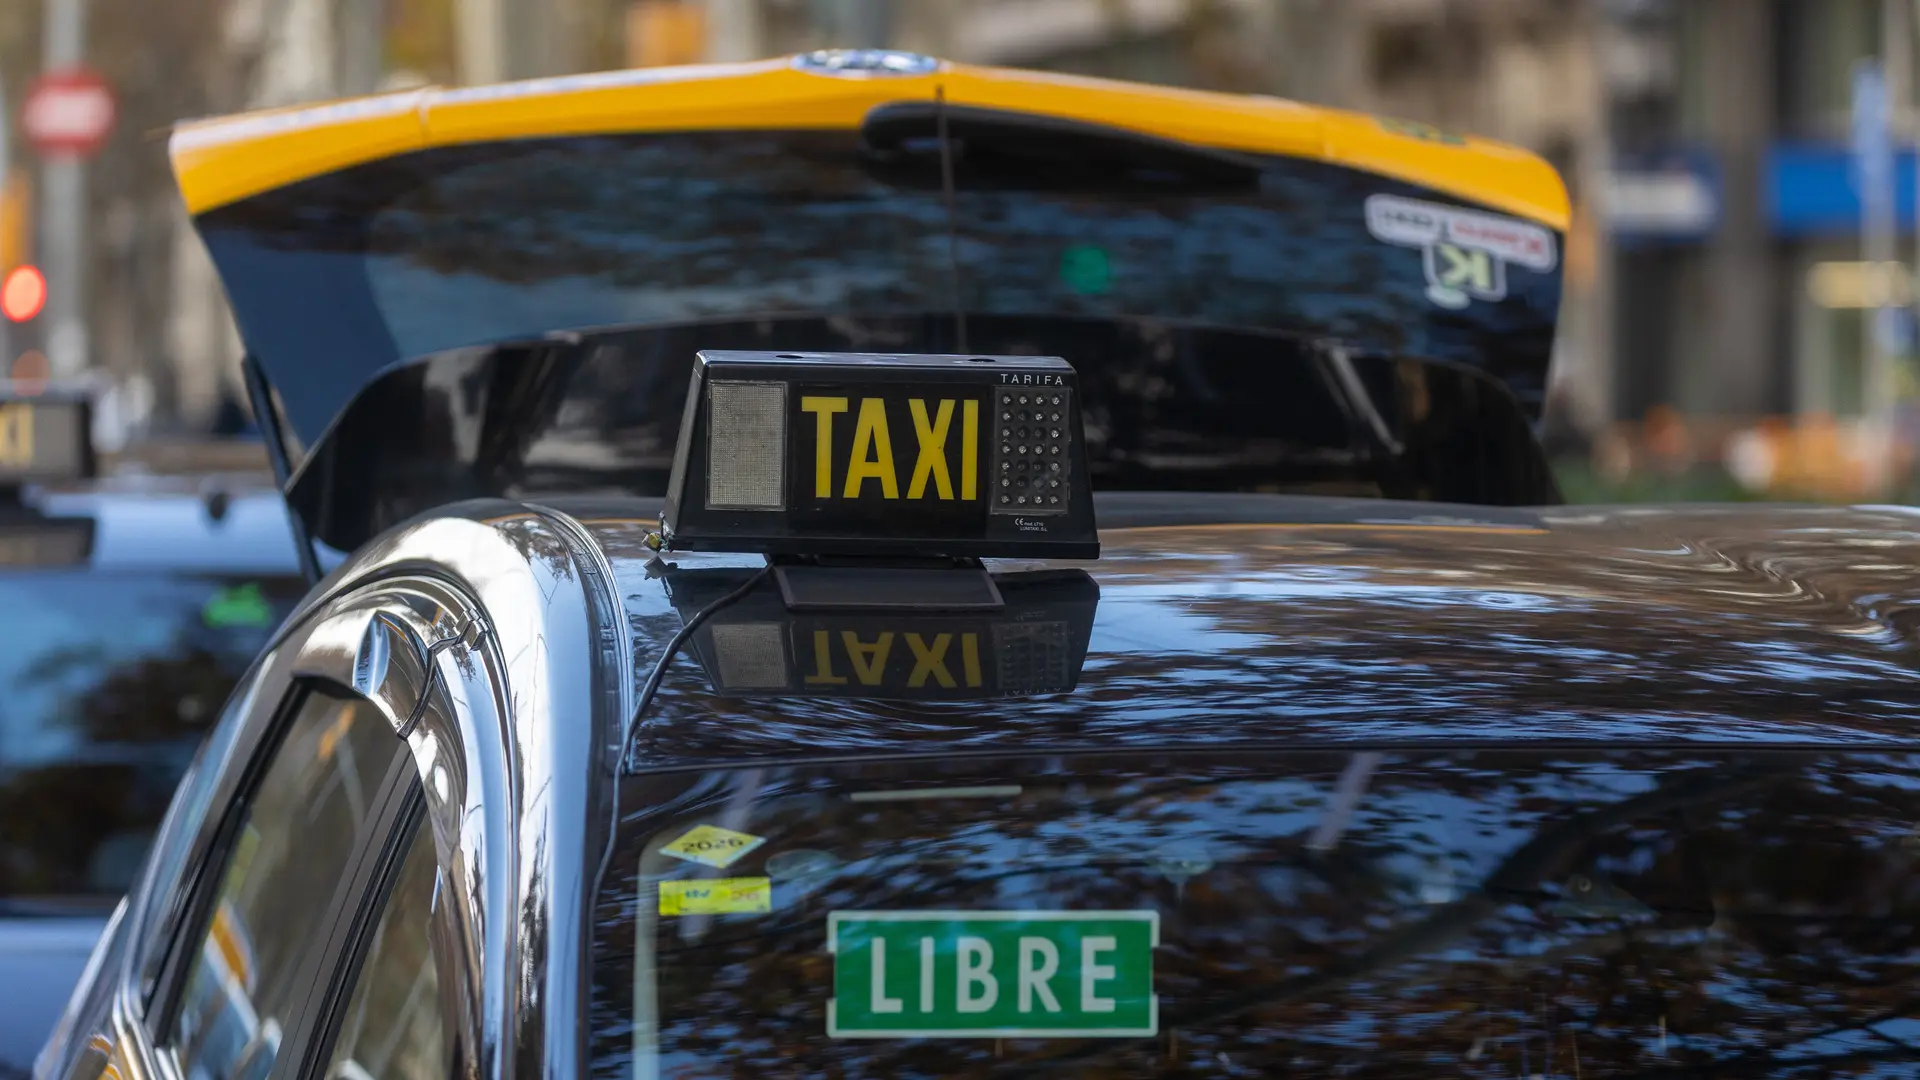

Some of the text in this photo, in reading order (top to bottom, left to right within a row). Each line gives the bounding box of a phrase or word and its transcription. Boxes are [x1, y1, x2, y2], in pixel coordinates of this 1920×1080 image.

[1000, 373, 1063, 385] TARIFA
[801, 396, 979, 501] TAXI
[682, 838, 744, 855] 2026
[870, 936, 1117, 1013] LIBRE
